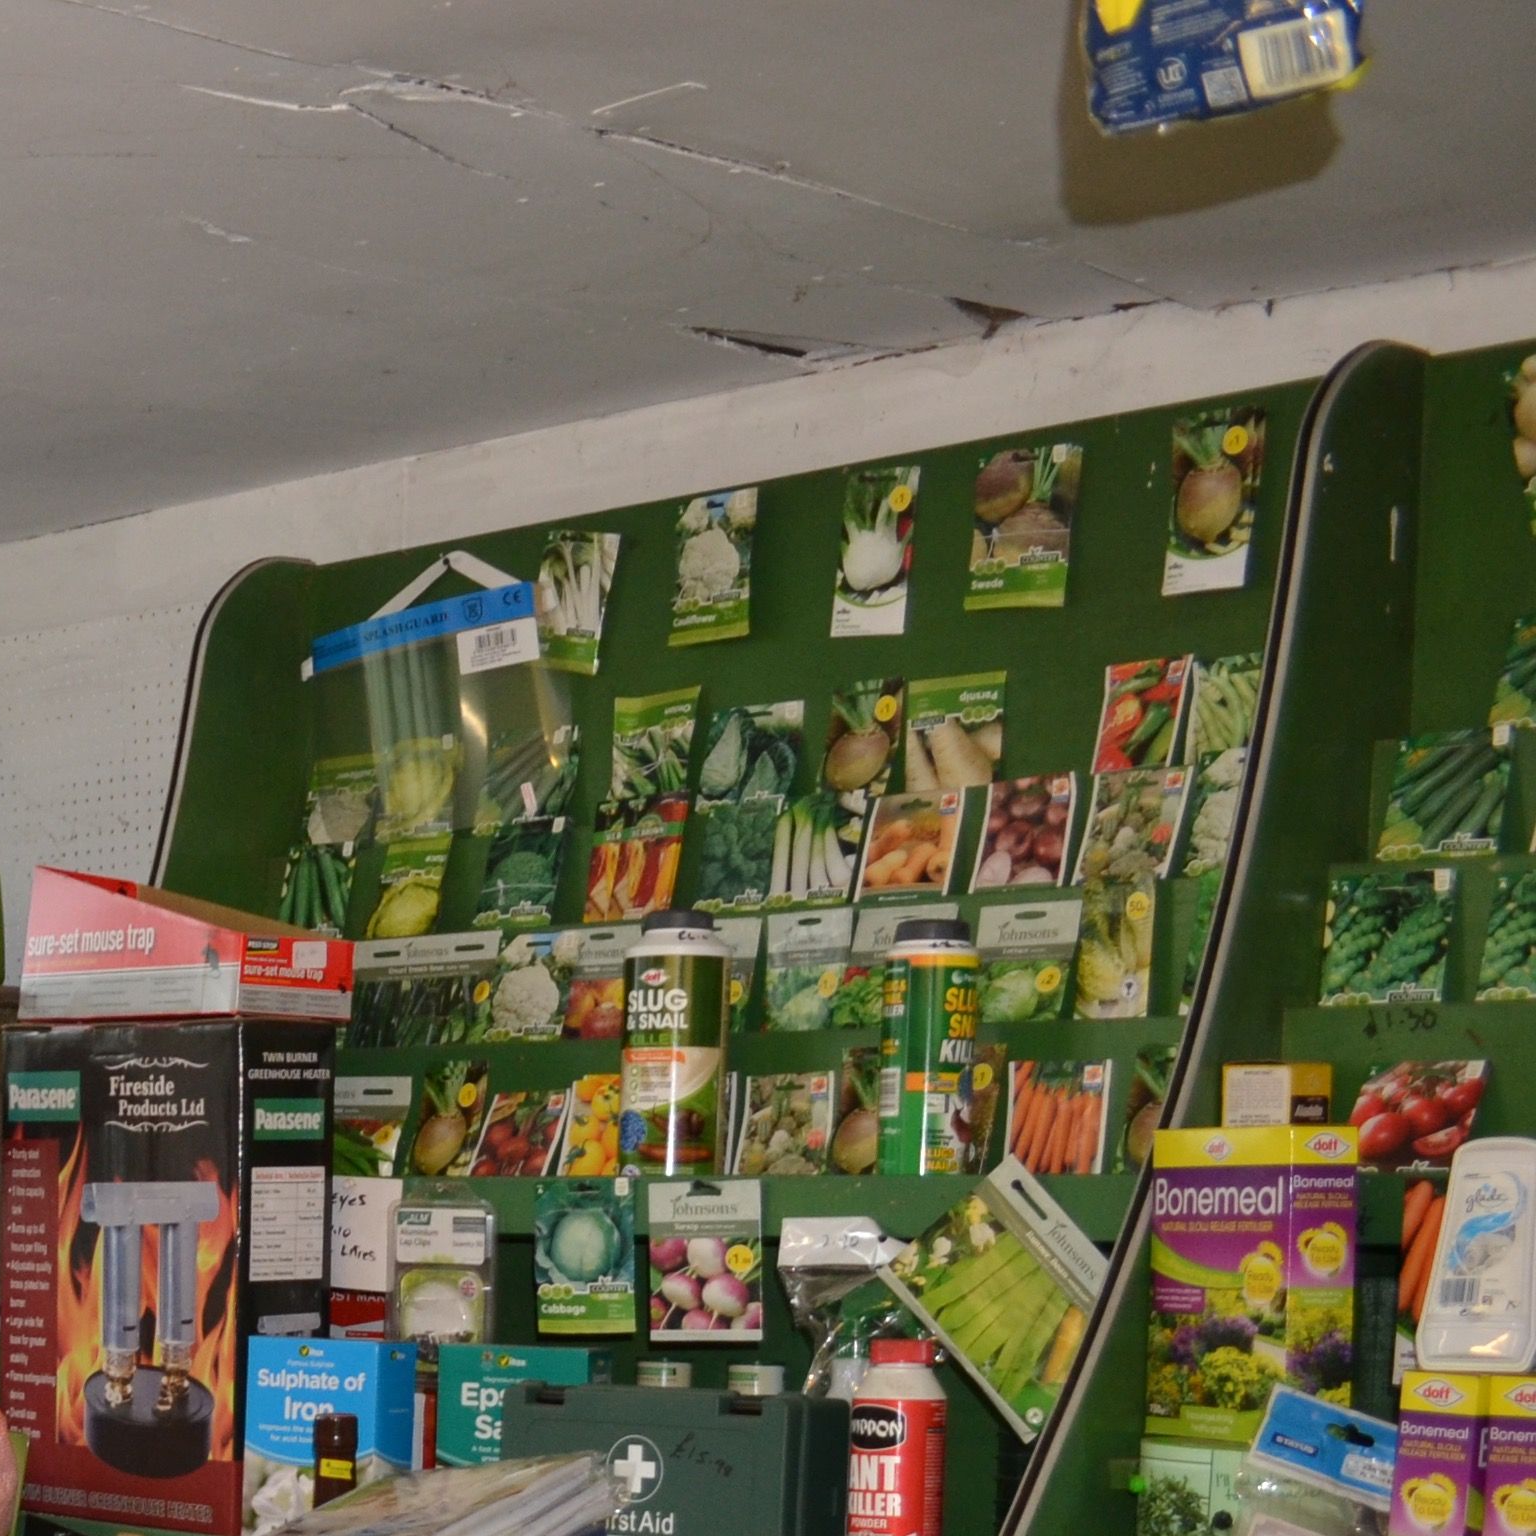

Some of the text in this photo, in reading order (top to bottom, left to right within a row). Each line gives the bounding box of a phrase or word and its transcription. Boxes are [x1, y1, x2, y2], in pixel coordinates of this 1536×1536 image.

[27, 924, 156, 957] sure-set mouse trap
[997, 922, 1060, 945] Johnsons
[243, 963, 324, 982] sure-set mouse trap
[628, 988, 688, 1014] SLUG
[638, 1012, 688, 1031] SNAIL
[262, 1052, 318, 1064] TWIN BURNER
[109, 1074, 175, 1097] Fireside
[248, 1068, 331, 1081] GREENHOUSE HEATER
[8, 1083, 76, 1111] Parasene
[118, 1098, 205, 1118] Products Ltd
[254, 1106, 322, 1133] Parasene
[1313, 1138, 1339, 1152] doff
[1293, 1175, 1355, 1188] Bonemeal
[1154, 1175, 1284, 1216] Bonemeal
[671, 1196, 738, 1219] Johnsons
[1046, 1220, 1097, 1282] Johnsons
[541, 1303, 586, 1316] Cabbage
[257, 1368, 365, 1394] Sulphate of
[1423, 1386, 1452, 1399] doff
[283, 1396, 334, 1421] Iron
[1400, 1420, 1469, 1440] Bonemeal
[849, 1454, 901, 1491] ANT
[638, 1510, 675, 1535] Aid
